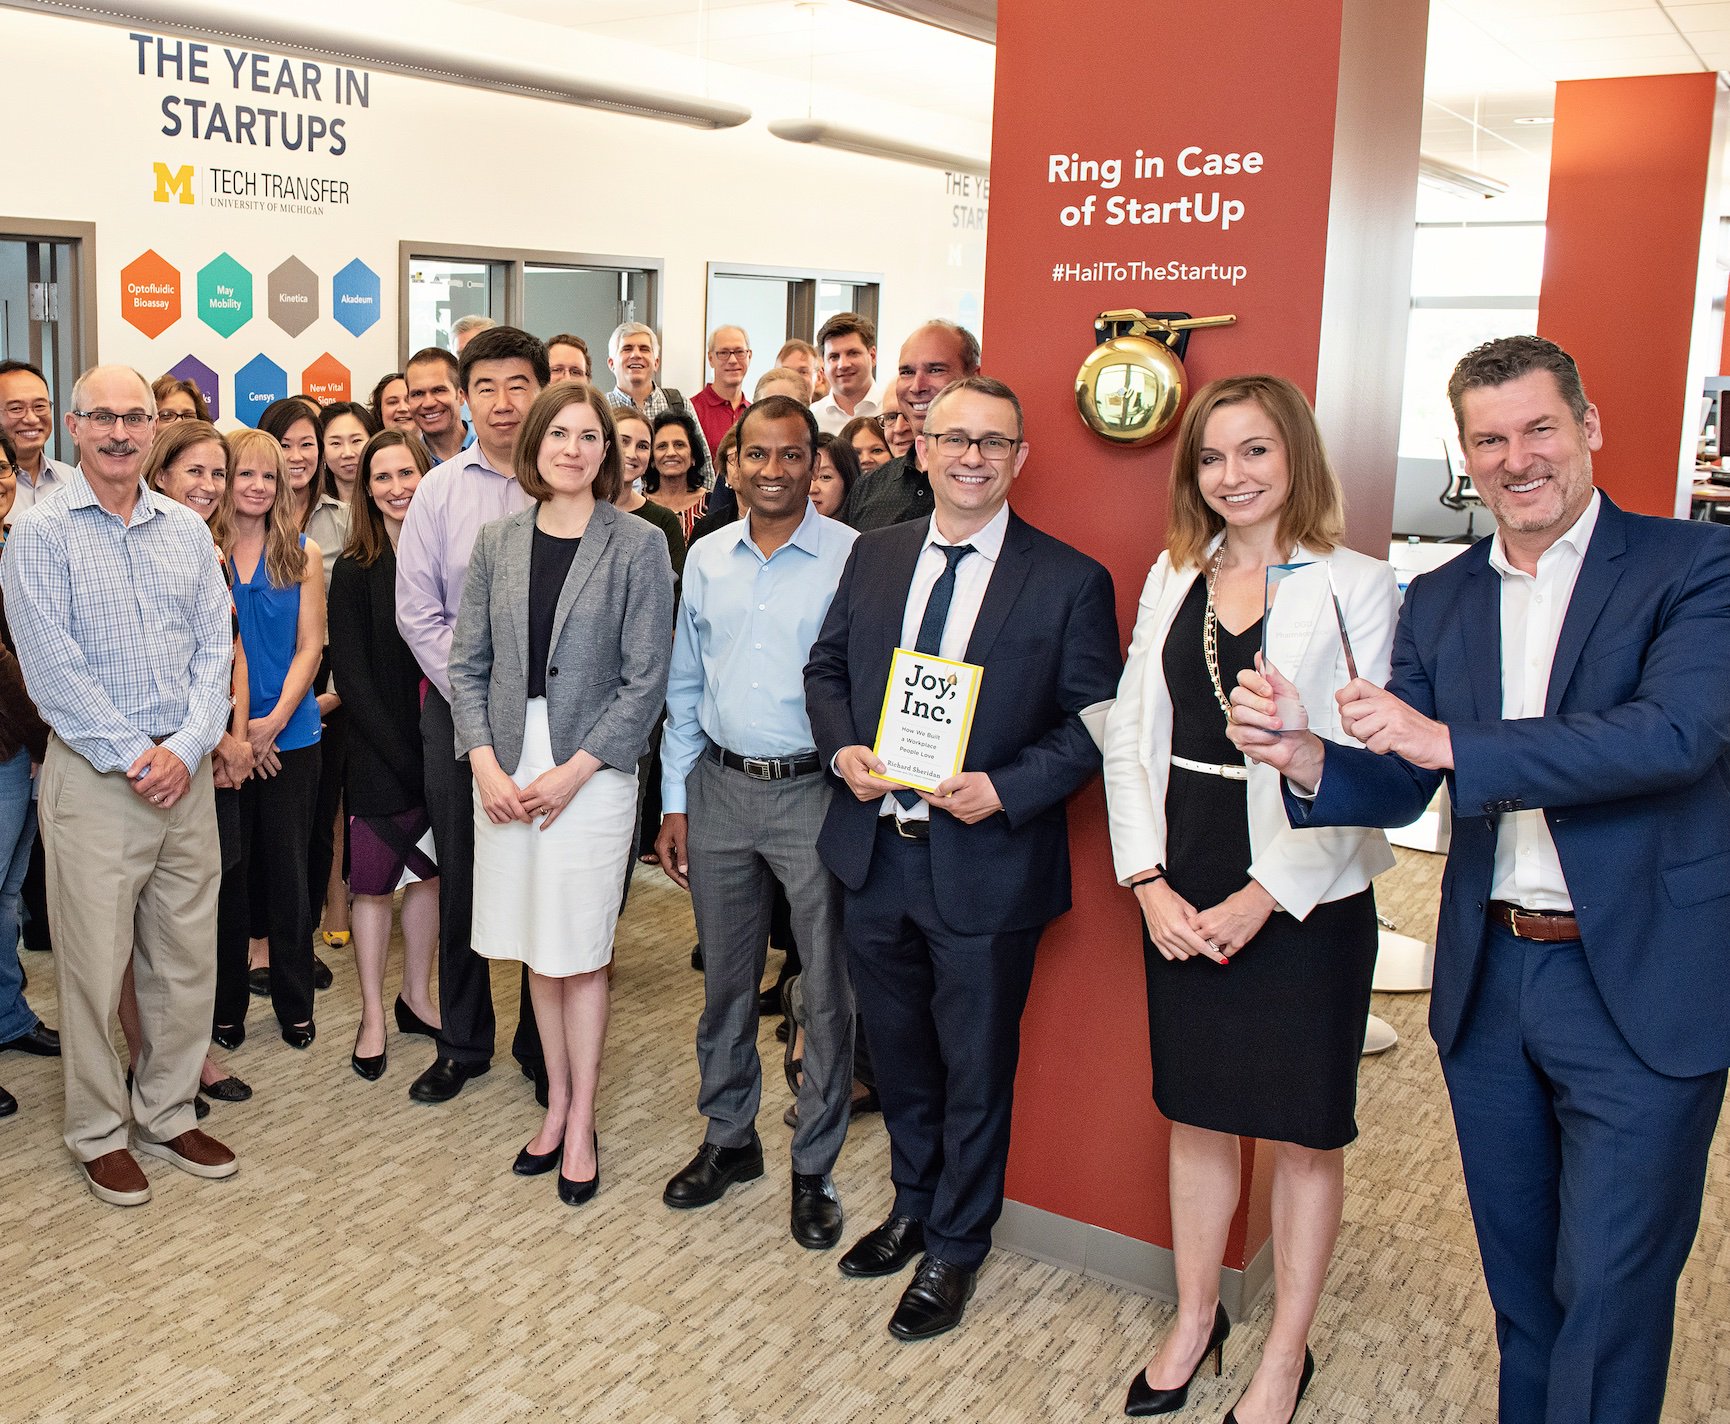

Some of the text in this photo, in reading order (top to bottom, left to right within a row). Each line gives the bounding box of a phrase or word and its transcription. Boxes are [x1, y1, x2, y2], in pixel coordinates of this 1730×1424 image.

[129, 32, 369, 108] THE YEAR IN
[161, 95, 346, 156] STARTUPS
[1048, 146, 1264, 189] Ring in Case
[153, 162, 194, 204] M
[210, 168, 349, 204] TECH TRANSFER
[210, 198, 324, 216] UNIVERSITY OF MICHIGAN
[1060, 192, 1245, 230] of StartUp
[1052, 261, 1248, 286] #HailToTheStartup
[128, 282, 174, 296] Optofluidic
[216, 284, 234, 298] May
[134, 297, 170, 310] Bioassay
[209, 297, 242, 311] Mobility
[279, 293, 308, 304] Kinetica
[341, 294, 372, 304] Akadeum
[310, 382, 344, 392] New Vital
[248, 392, 274, 404] Censys
[317, 396, 336, 406] Signs
[905, 664, 956, 700] Joy,
[900, 691, 952, 724] Inc.
[902, 726, 914, 734] How
[927, 732, 940, 740] Built
[906, 738, 937, 750] Workplace
[900, 746, 935, 760] People Love
[887, 760, 912, 772] Richard
[912, 766, 940, 779] Sheridan
